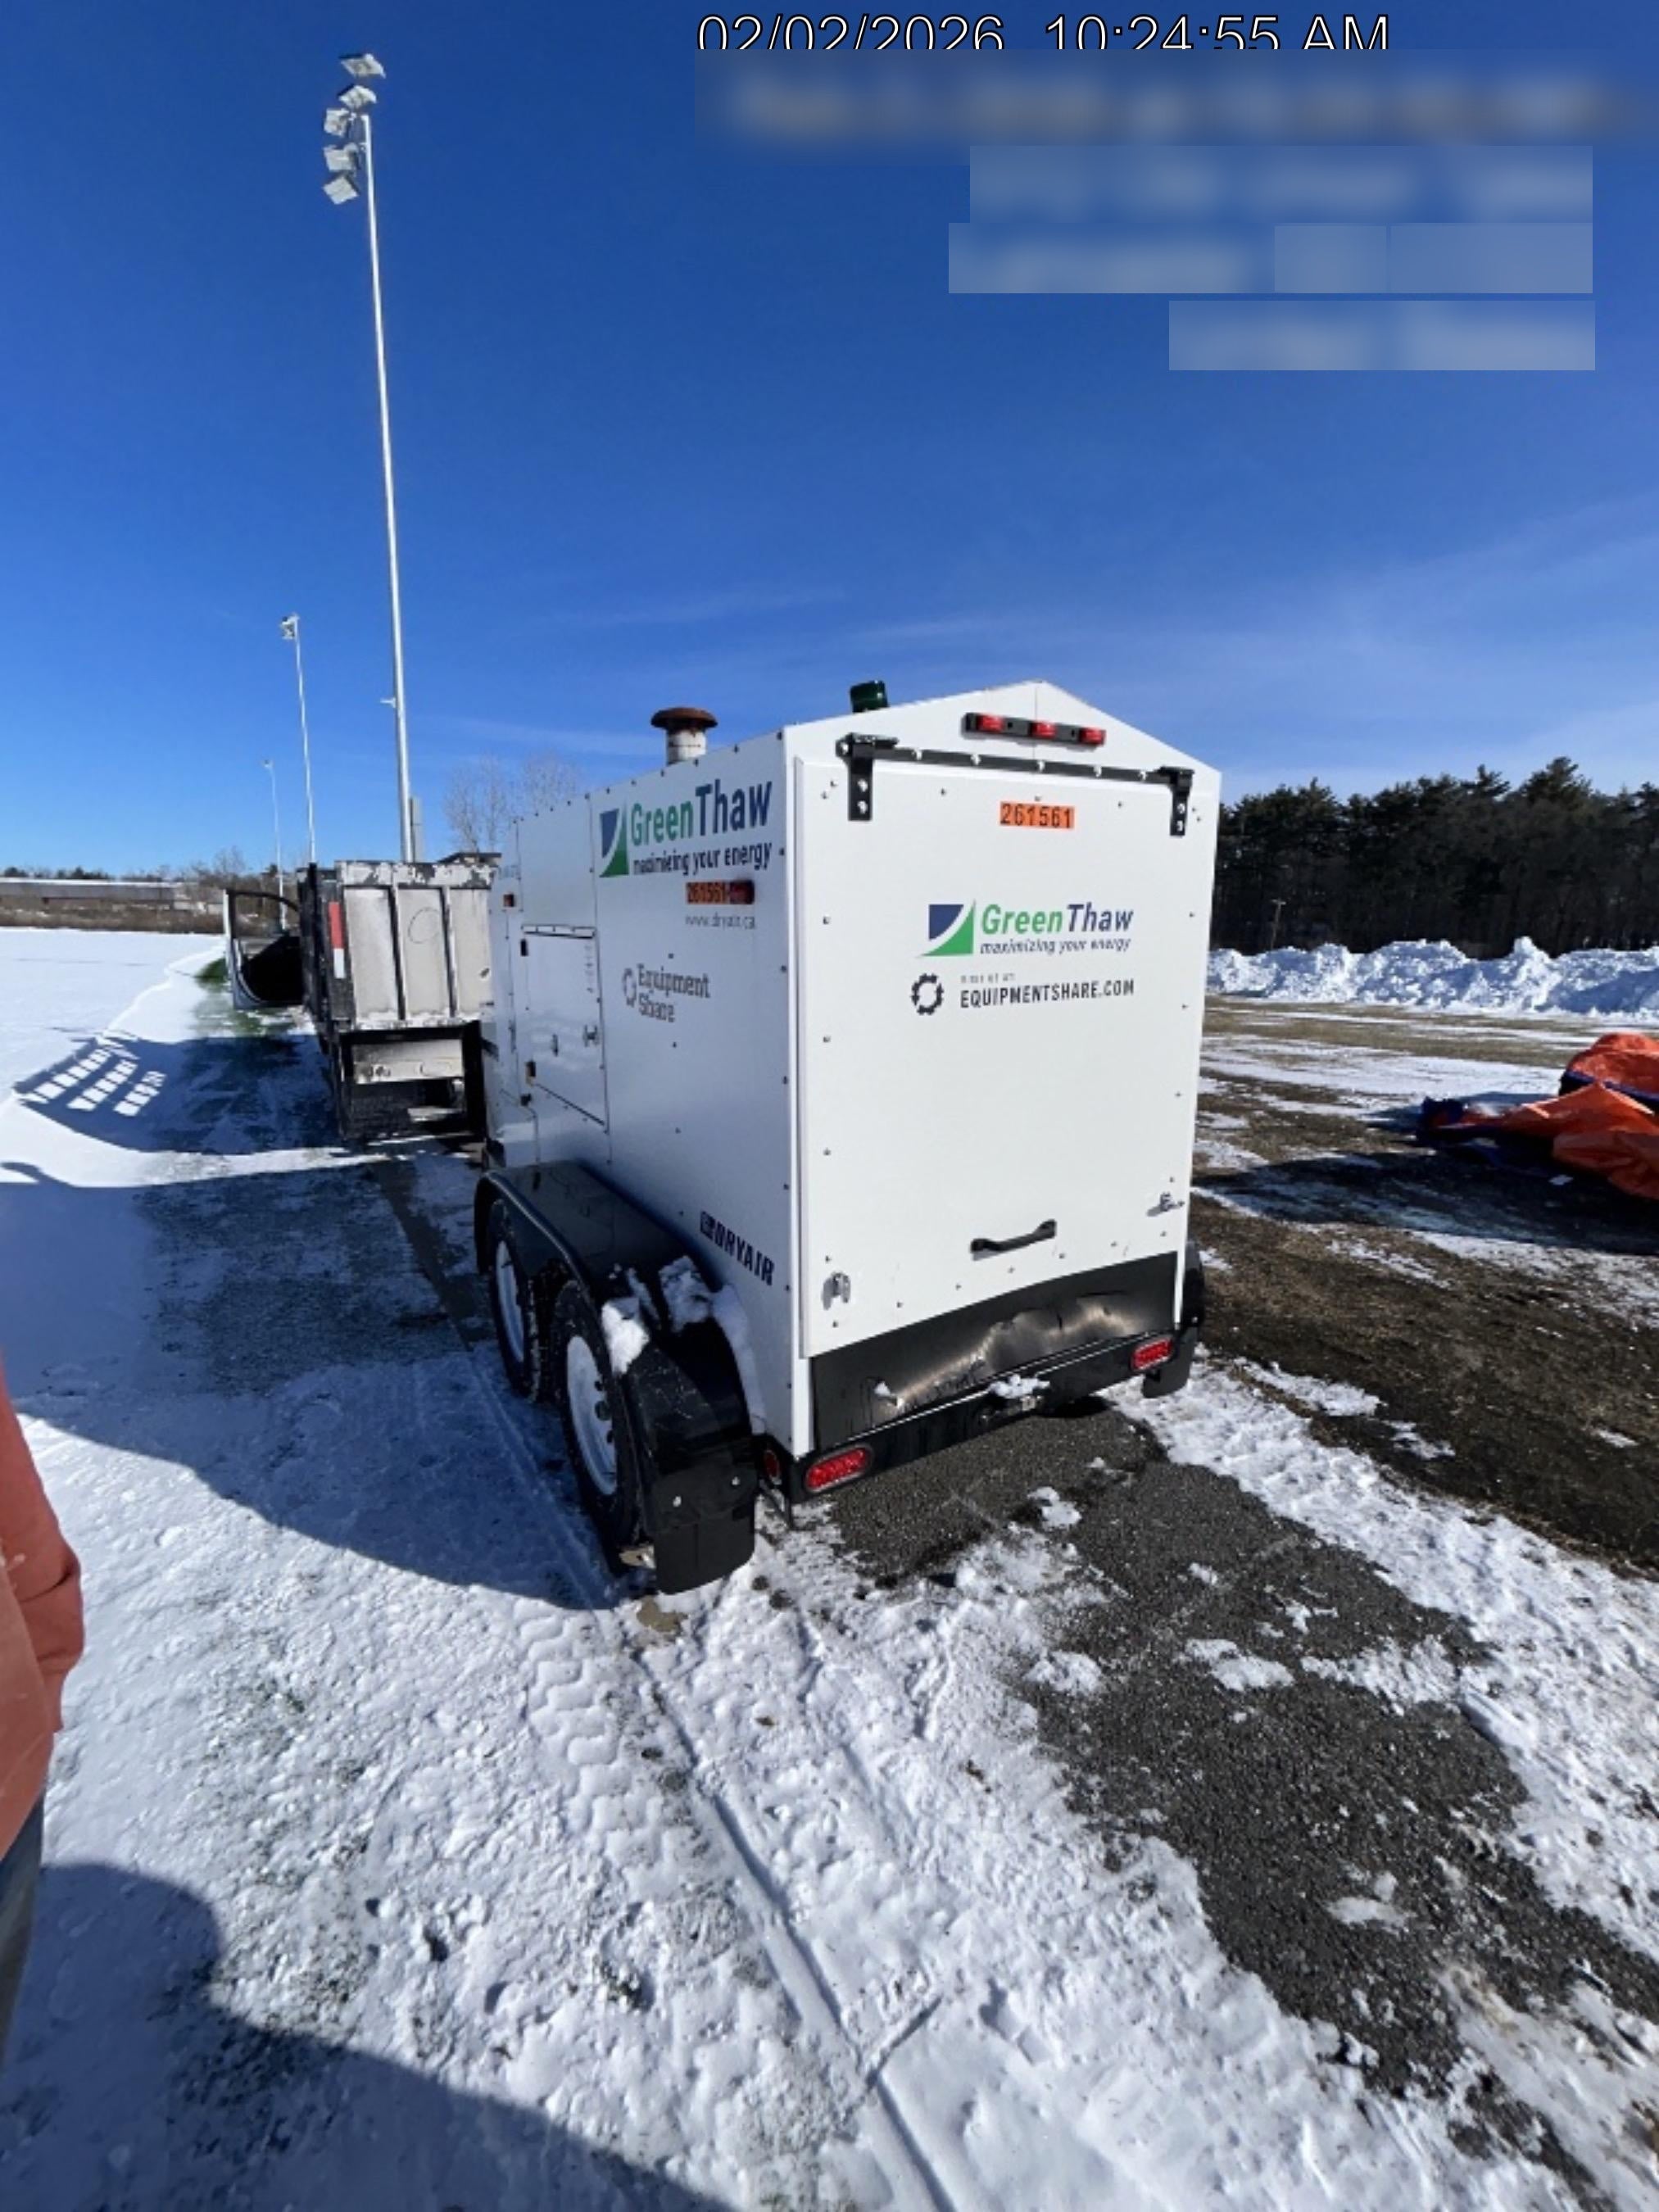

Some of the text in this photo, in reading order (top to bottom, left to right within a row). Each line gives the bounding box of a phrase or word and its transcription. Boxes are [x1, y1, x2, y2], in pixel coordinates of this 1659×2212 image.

[999, 802, 1073, 828] 261561
[692, 849, 721, 875] your
[724, 842, 773, 871] energy
[980, 938, 1131, 955] maximizing your energy
[637, 963, 710, 999] Equipment
[960, 978, 1135, 1009] EQUIPMENTSHARE.COM
[638, 993, 676, 1023] Share
[714, 1221, 775, 1286] DRYAIR
